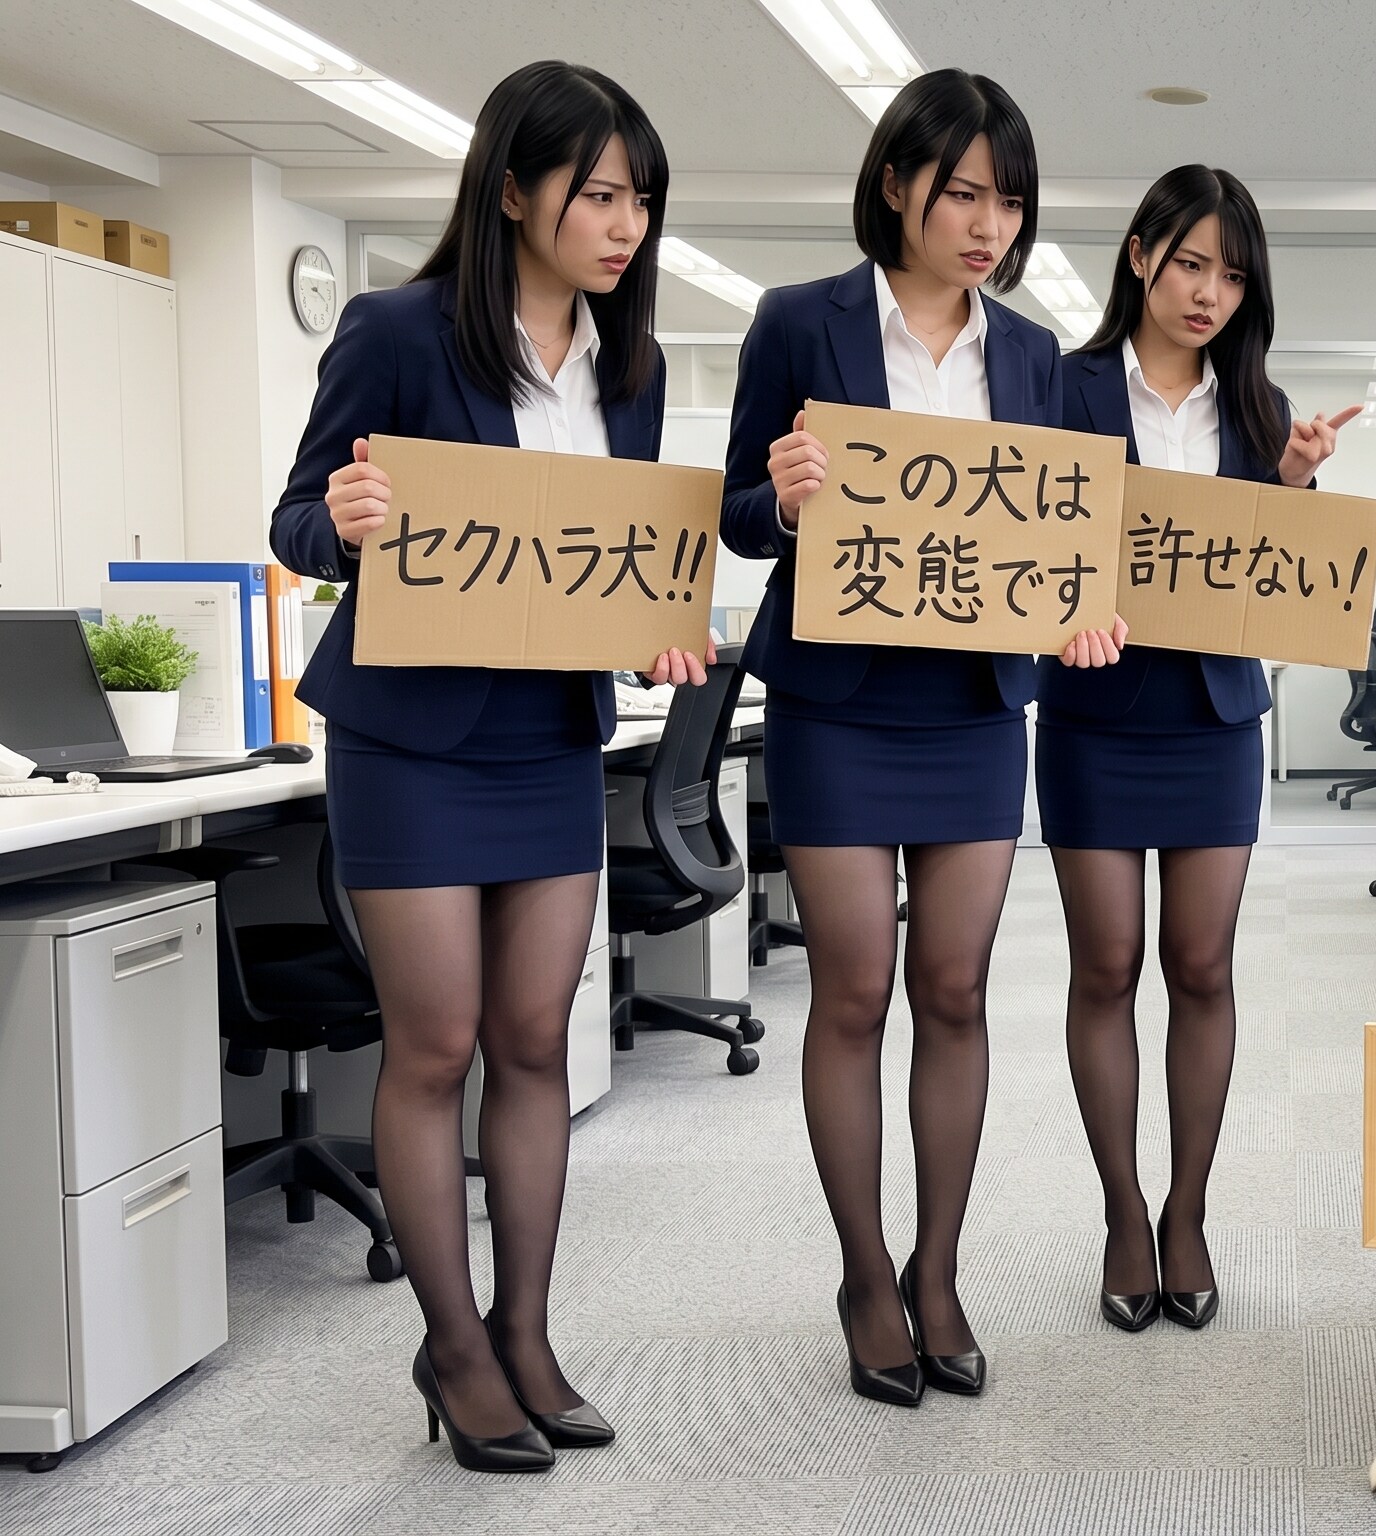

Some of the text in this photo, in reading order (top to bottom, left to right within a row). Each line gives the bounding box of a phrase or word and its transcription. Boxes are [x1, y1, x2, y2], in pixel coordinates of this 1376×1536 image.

[840, 442, 1091, 522] この犬は
[379, 512, 708, 603] セクハラ犬!!
[833, 524, 1098, 625] 変態です
[1127, 512, 1368, 612] 許せない!
